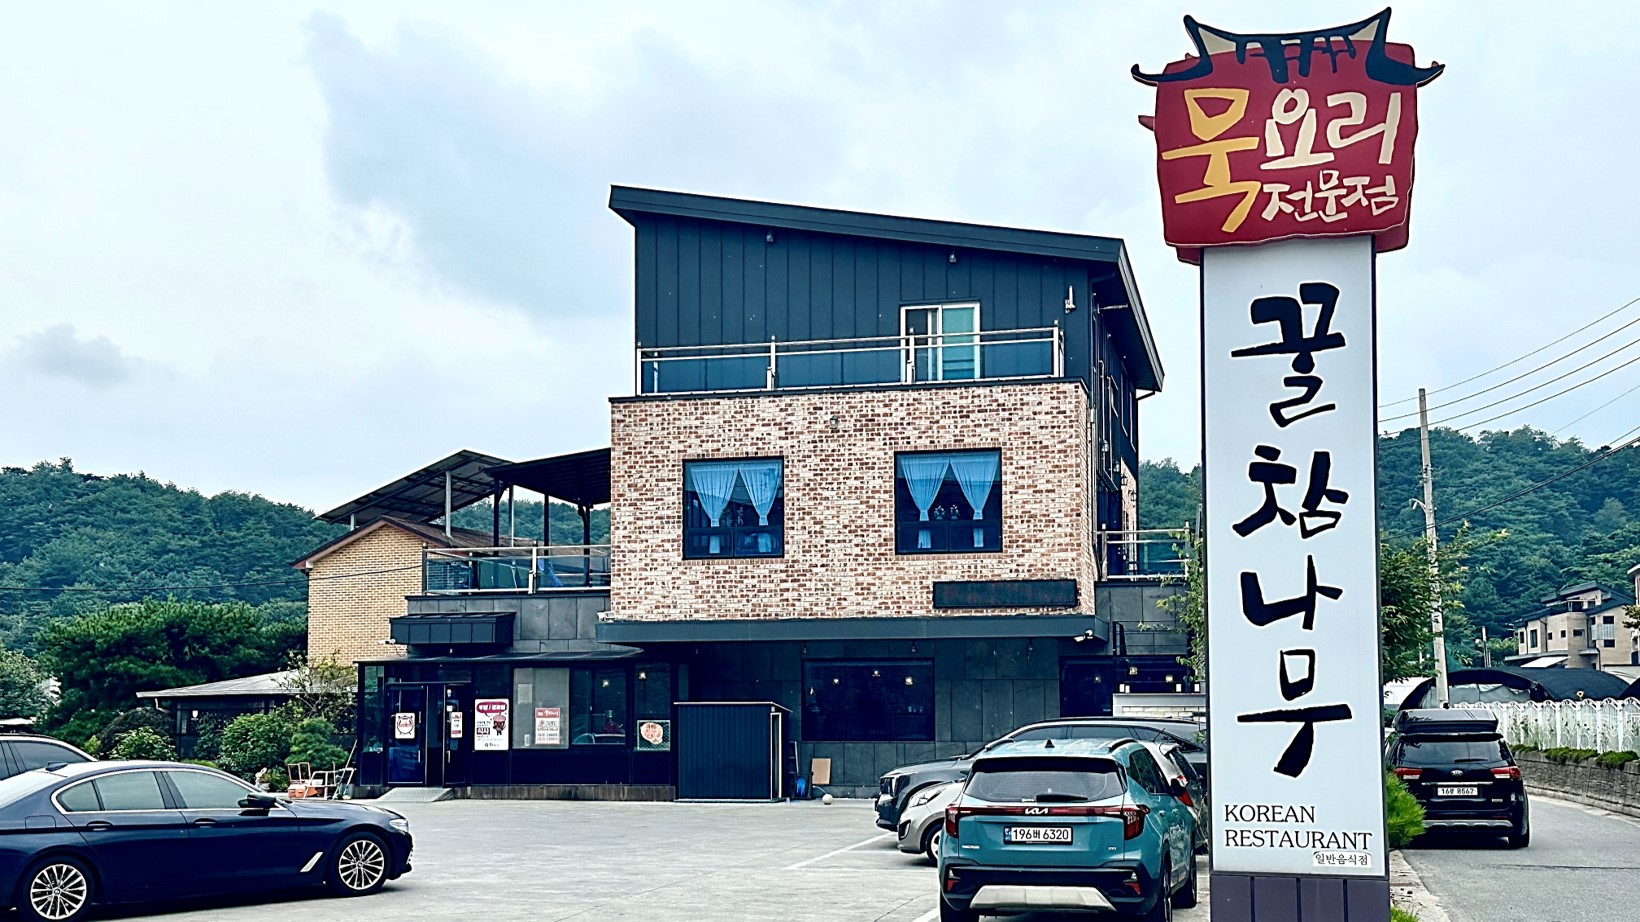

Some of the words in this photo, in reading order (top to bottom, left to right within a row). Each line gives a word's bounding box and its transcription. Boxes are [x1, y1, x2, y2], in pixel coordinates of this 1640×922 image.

[1261, 169, 1399, 222] 전문점
[1230, 281, 1353, 779] 꿀참나무
[1224, 804, 1316, 823] KOREAN
[1042, 828, 1069, 840] 6320
[1224, 829, 1373, 850] RESTAURANT
[1315, 853, 1369, 866] 일반음식점
